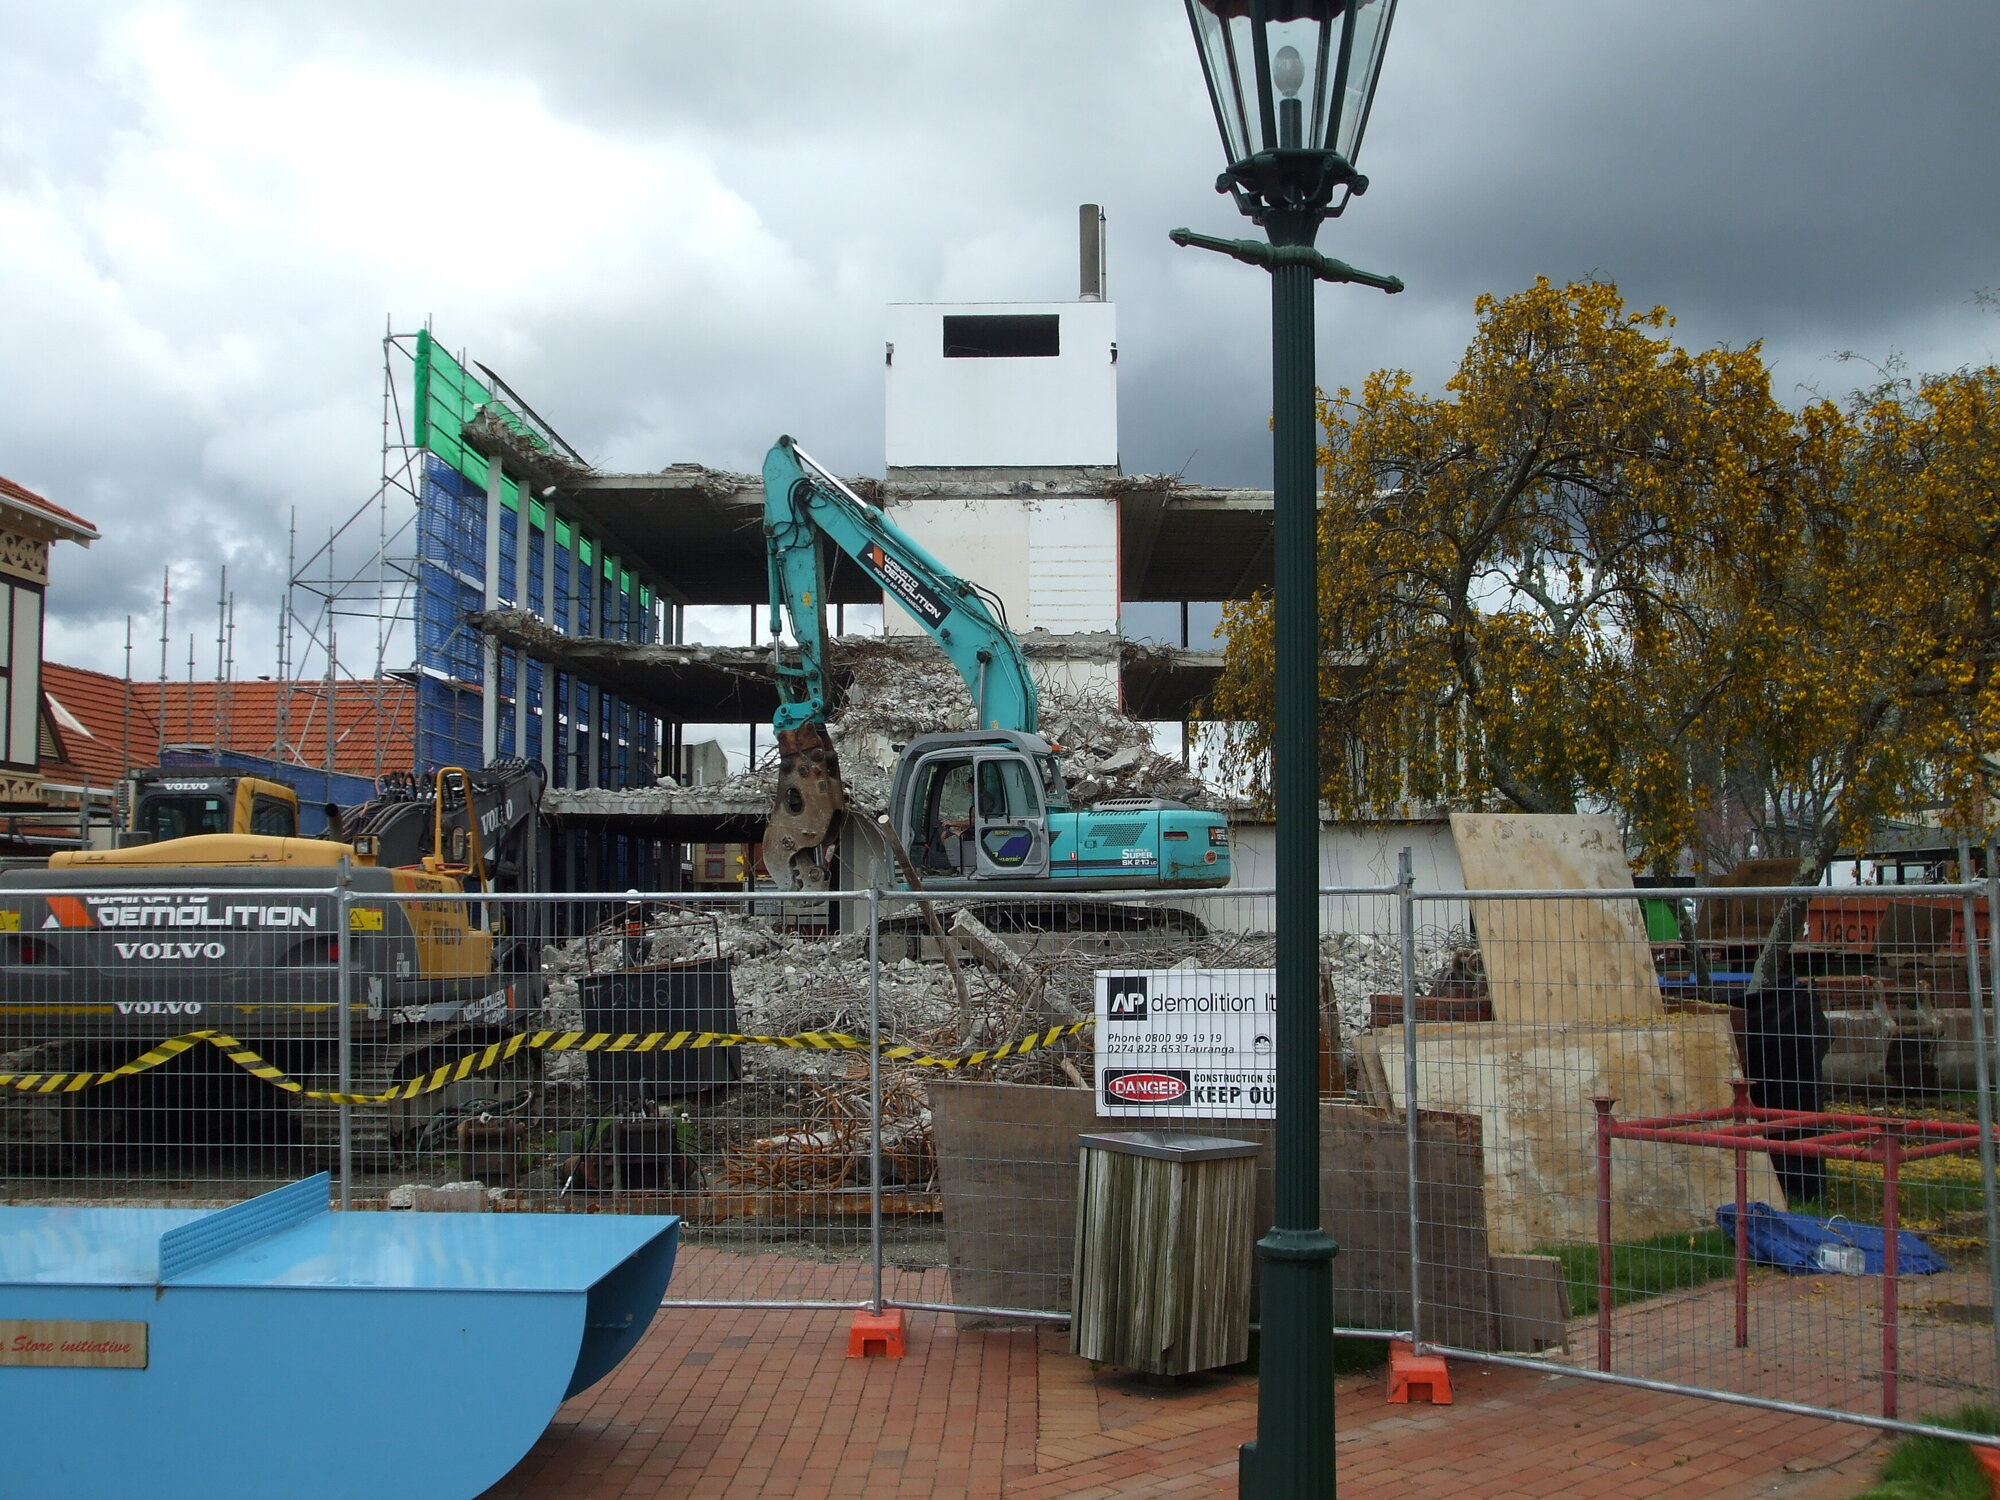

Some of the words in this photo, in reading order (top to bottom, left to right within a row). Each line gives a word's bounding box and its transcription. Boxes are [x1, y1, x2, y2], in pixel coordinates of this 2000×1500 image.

[883, 554, 919, 589] WAIKATO
[884, 563, 941, 619] DEMOLITION
[163, 782, 209, 791] VOLVO
[480, 799, 513, 836] VOLO
[1121, 848, 1153, 859] SUPER
[97, 906, 316, 927] DEMOLITION
[114, 942, 225, 959] VOLVO
[115, 1001, 201, 1015] VOLVO
[1110, 992, 1145, 1013] AP
[1151, 992, 1256, 1012] demolition
[1264, 992, 1277, 1012] lt
[1108, 1033, 1141, 1043] Phone
[1145, 1033, 1171, 1043] 0800
[1175, 1033, 1188, 1043] 99
[1193, 1033, 1205, 1043] 19
[1210, 1033, 1222, 1043] 19
[1107, 1044, 1134, 1054] 0274
[1137, 1044, 1157, 1054] 823
[1161, 1044, 1181, 1054] 653
[1184, 1044, 1235, 1056] Tauranga
[1193, 1073, 1263, 1083] CONSTRUCTION
[1266, 1074, 1277, 1083] SI
[1115, 1081, 1180, 1095] DANGER
[1193, 1086, 1241, 1103] KEEP
[1248, 1087, 1276, 1104] OU
[12, 1336, 54, 1352] Store
[60, 1341, 131, 1352] initiative
